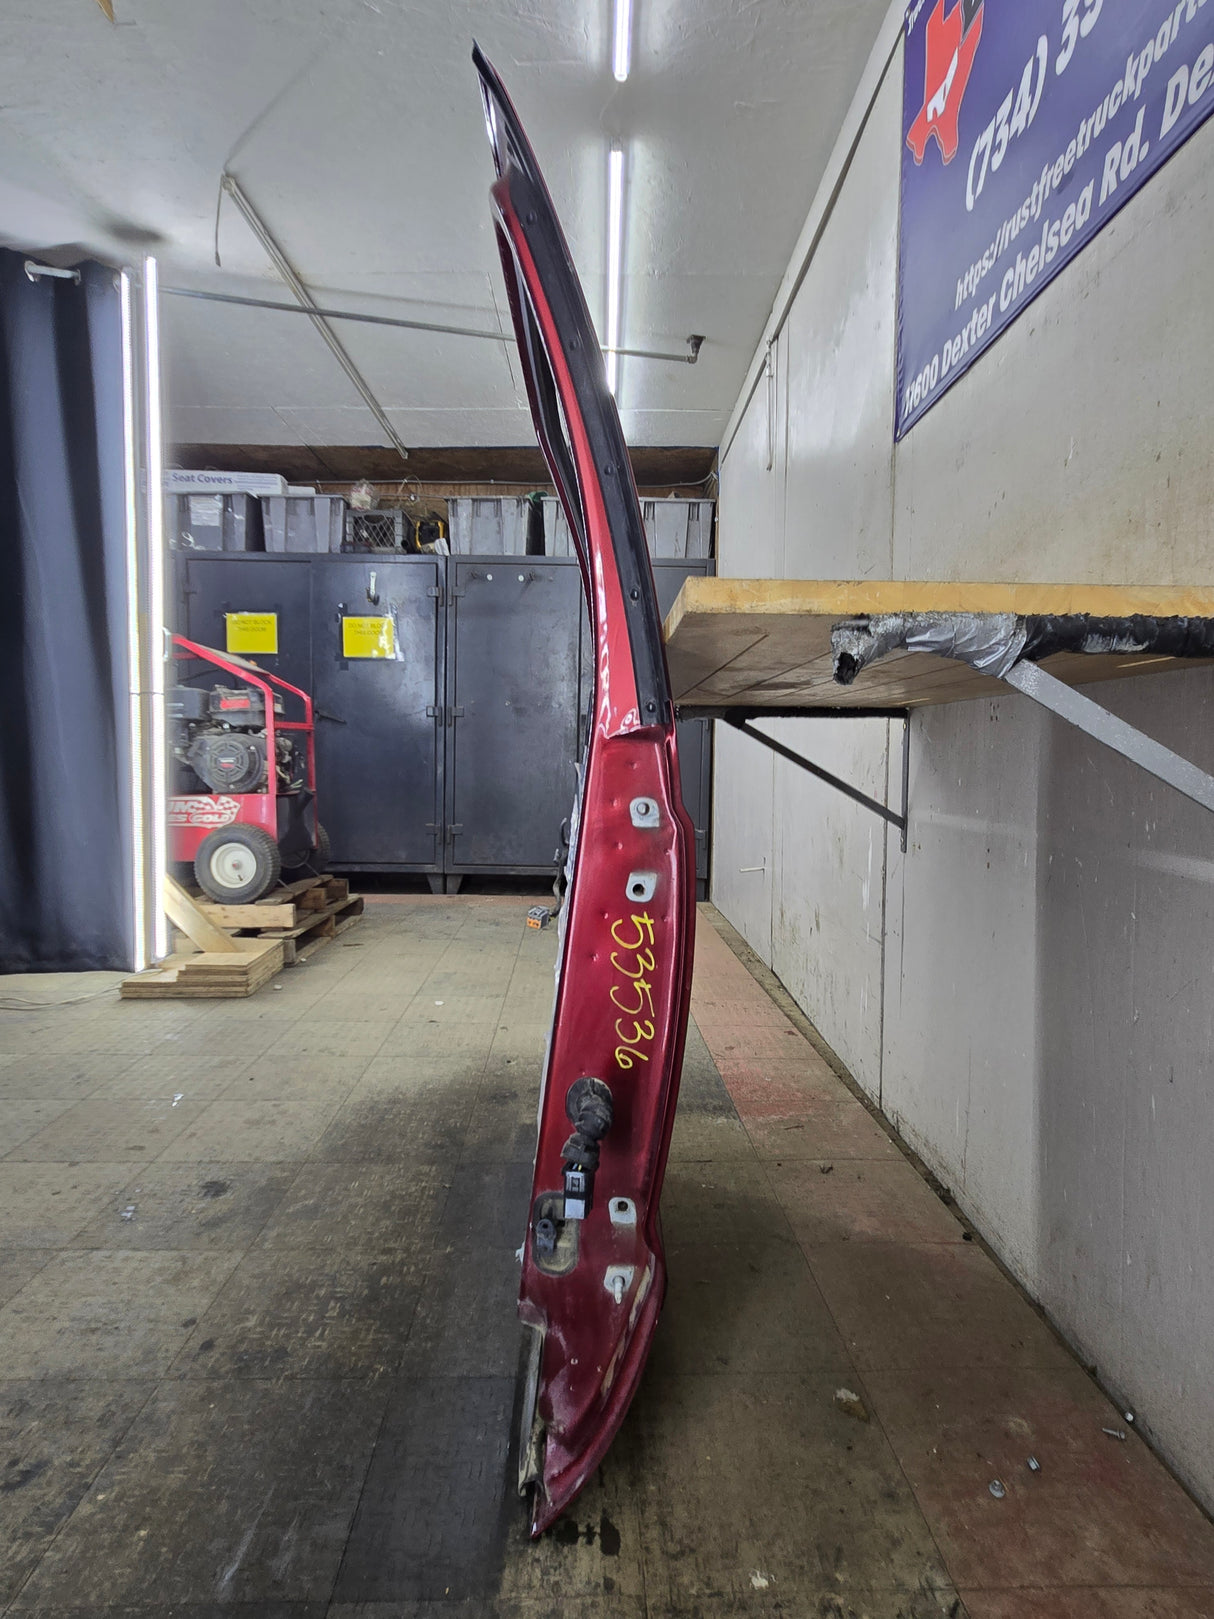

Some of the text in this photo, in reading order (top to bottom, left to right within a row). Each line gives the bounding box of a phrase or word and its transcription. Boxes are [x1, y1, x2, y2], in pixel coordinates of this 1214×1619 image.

[941, 291, 997, 379] Dexter
[999, 178, 1095, 313] Chelsea
[1098, 103, 1150, 207] Rd.
[1158, 42, 1214, 142] De
[954, 0, 1209, 312] https://rustfreetruckpart
[966, 34, 1049, 212] (734)
[172, 472, 196, 481] Seat
[197, 473, 233, 484] Covers
[610, 911, 655, 1069] 53536
